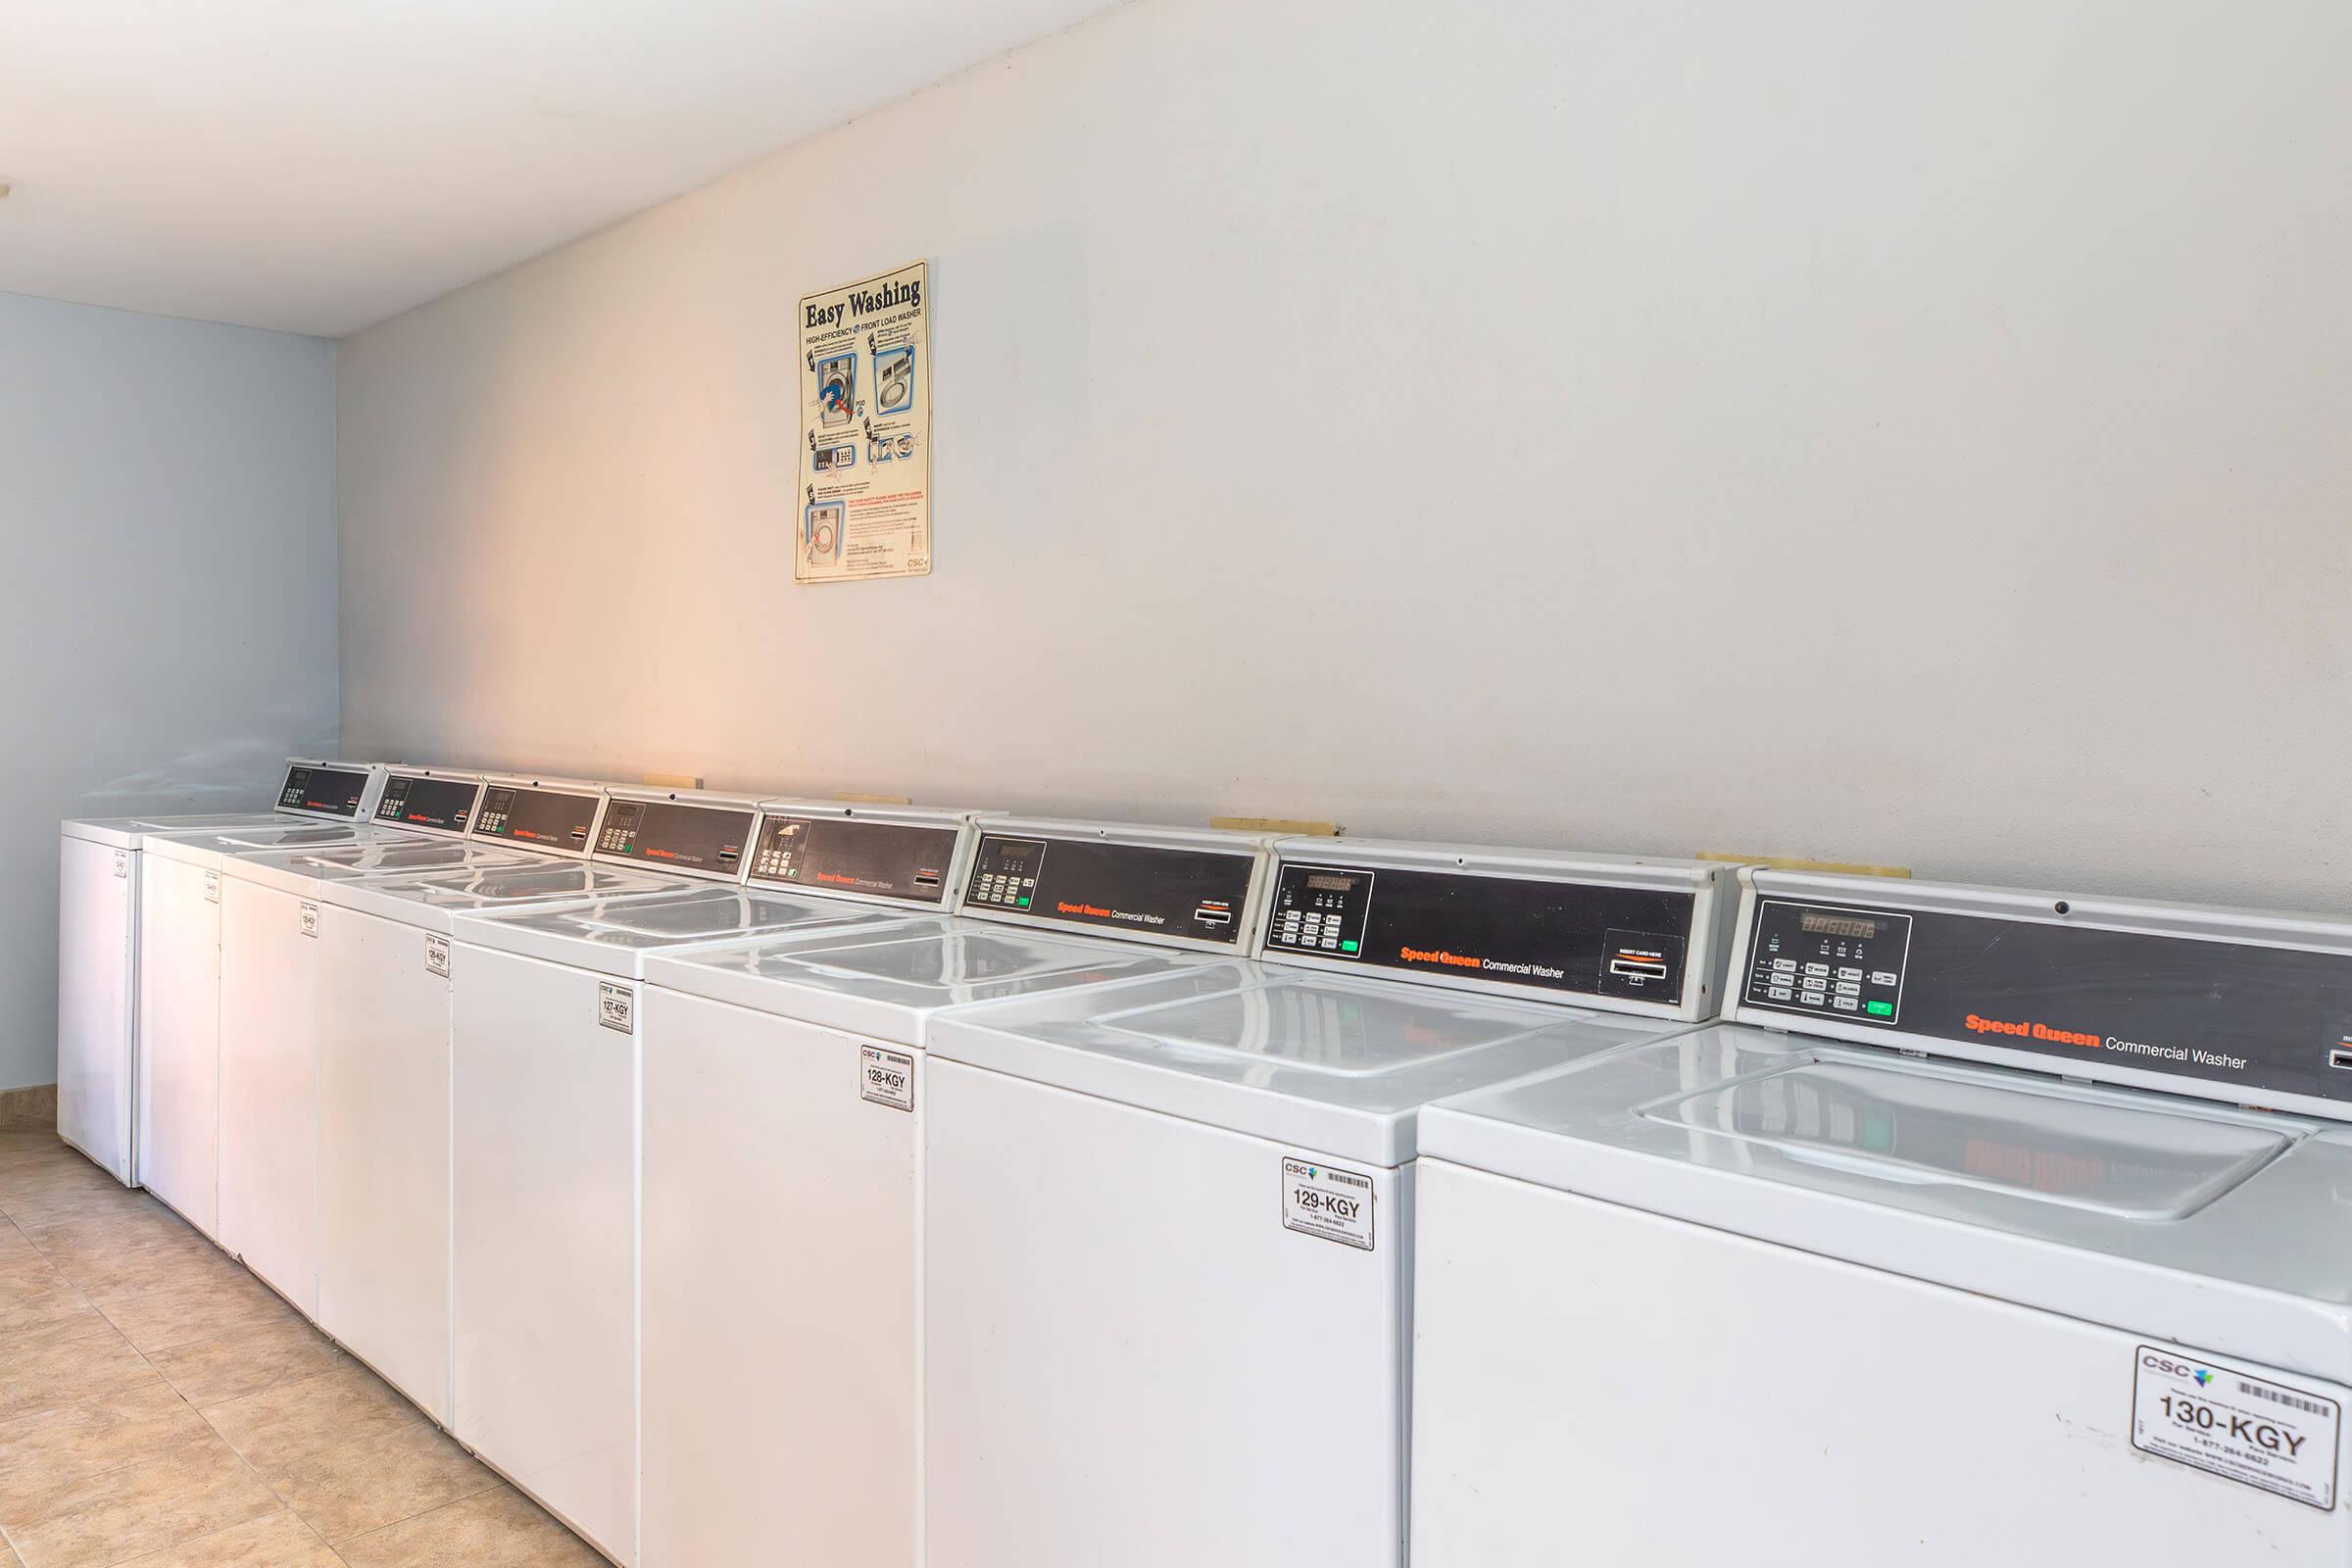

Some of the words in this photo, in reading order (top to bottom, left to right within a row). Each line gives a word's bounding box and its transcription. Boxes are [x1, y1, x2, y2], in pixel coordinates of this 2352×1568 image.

[806, 303, 845, 328] Easy
[849, 280, 921, 317] Washing
[807, 327, 853, 345] HIGH-EFFICIENCY
[860, 319, 880, 331] FRONT
[881, 315, 898, 326] LOAD
[898, 309, 921, 321] WASHER
[1057, 901, 1083, 913] Speed
[1111, 909, 1144, 922] Commercial
[1144, 913, 1165, 925] Washer
[1400, 947, 1440, 962] Speed
[1441, 951, 1481, 968] Queen
[1483, 958, 1531, 975] Commercial
[1532, 963, 1565, 979] Washer
[862, 1050, 875, 1058] CSC
[1965, 1012, 2030, 1038] Speed
[2033, 1023, 2100, 1049] Queen
[2105, 1036, 2188, 1062] Commercial
[2191, 1049, 2247, 1070] Washer
[867, 1069, 905, 1089] 128-KGY
[1285, 1163, 1307, 1175] CSC
[1294, 1189, 1360, 1218] 129-KGY
[2142, 1355, 2191, 1378] CSC
[2160, 1396, 2306, 1456] 130-KGY
